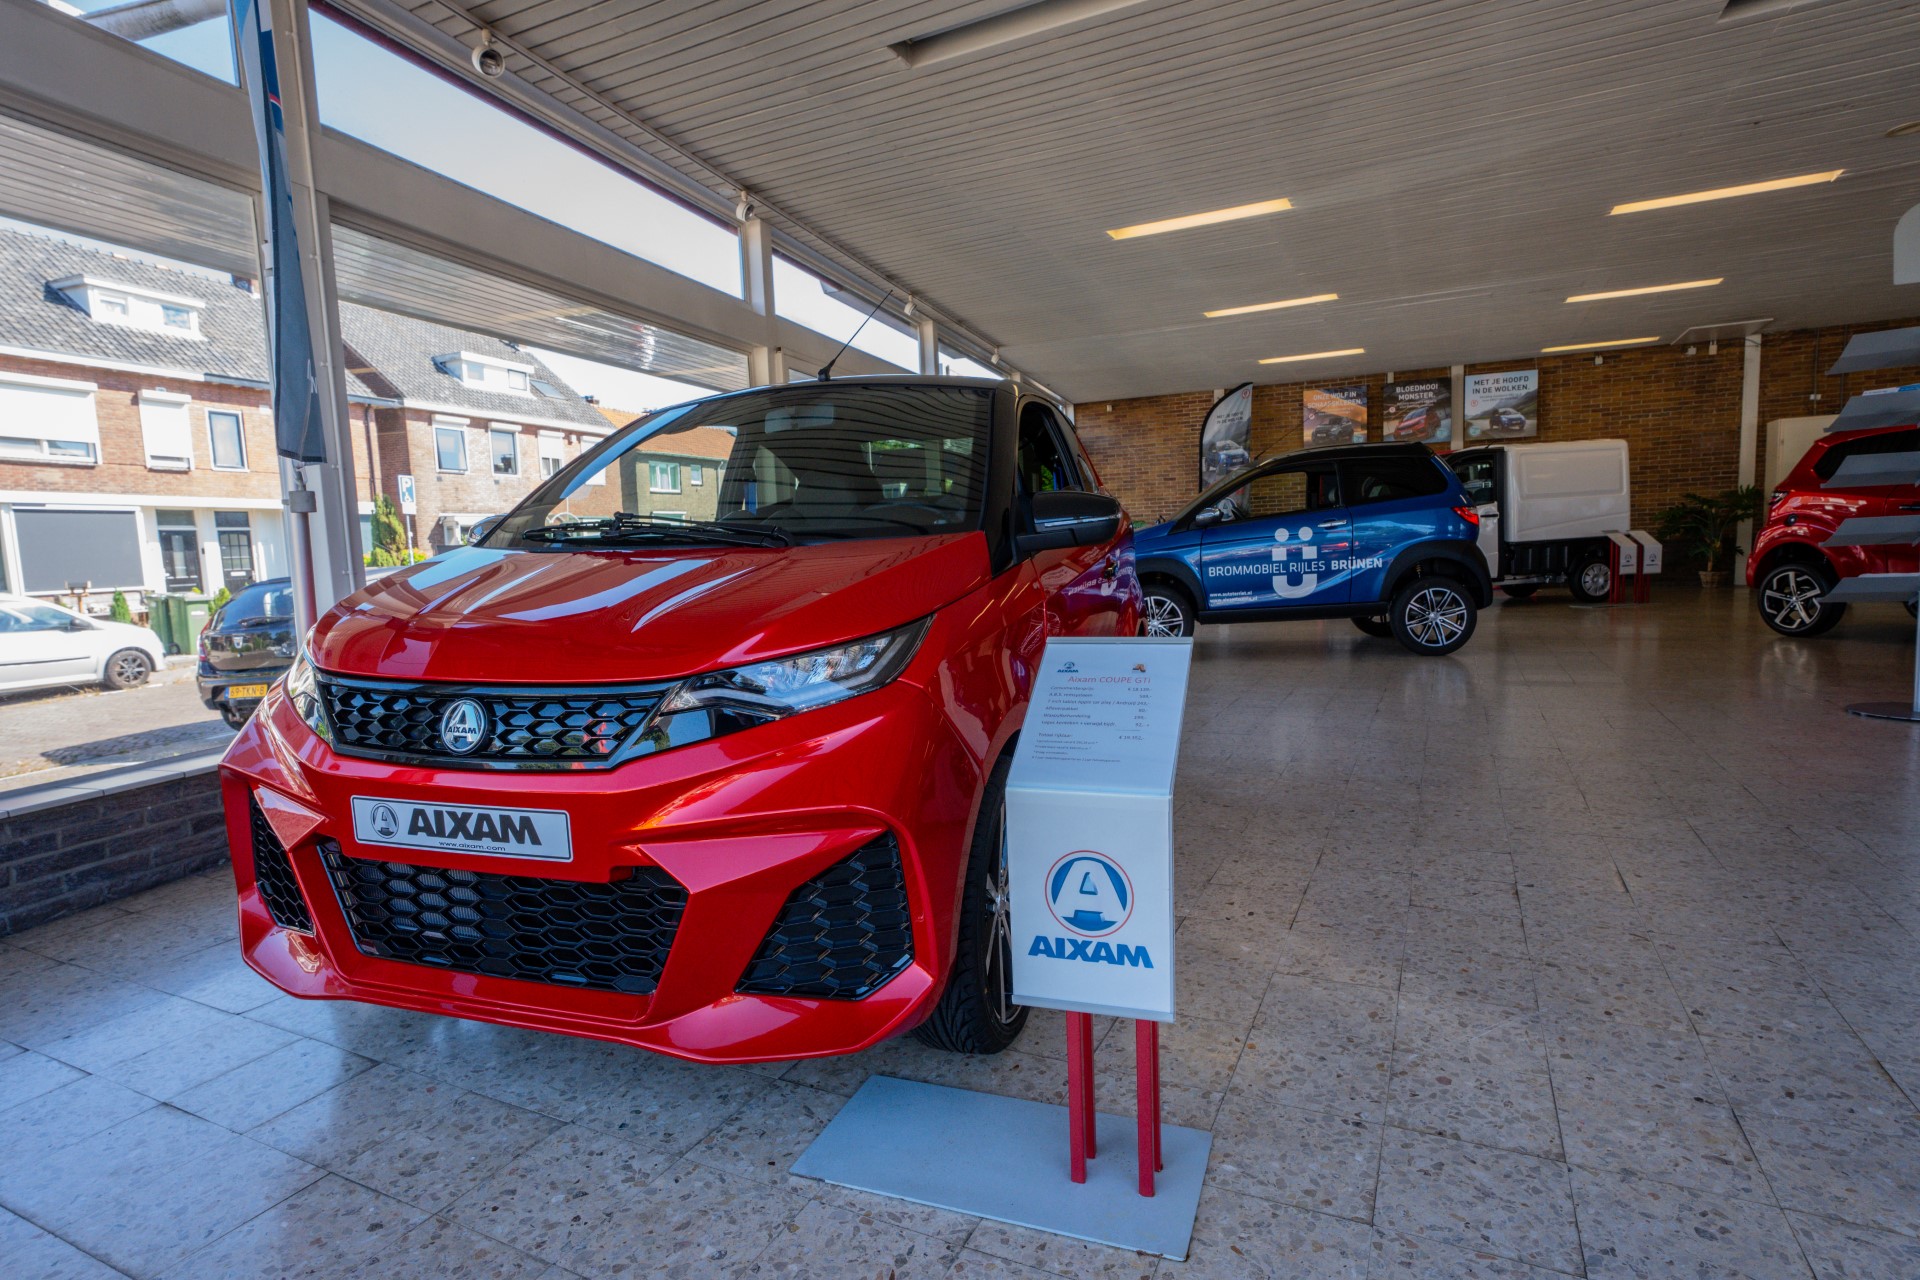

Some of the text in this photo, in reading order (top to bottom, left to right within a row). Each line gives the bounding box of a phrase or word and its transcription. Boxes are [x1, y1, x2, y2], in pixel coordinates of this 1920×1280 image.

[1474, 375, 1529, 386] MET JE HOOFD
[1396, 383, 1439, 393] BLOEDMOOI
[1472, 384, 1531, 395] IN DE WOLKEN.
[1331, 391, 1349, 399] WOLF
[1398, 391, 1436, 401] MONSTER.
[401, 477, 412, 492] P
[1208, 556, 1383, 577] BROMMOBIEL RIJLES BRÜNEN
[1067, 676, 1097, 684] Aixam
[1099, 676, 1132, 684] COUPE
[446, 725, 478, 735] AIXAM
[407, 807, 542, 846] AIXAM
[438, 840, 506, 852] www.aixam.com
[1027, 935, 1154, 969] AIXAM
